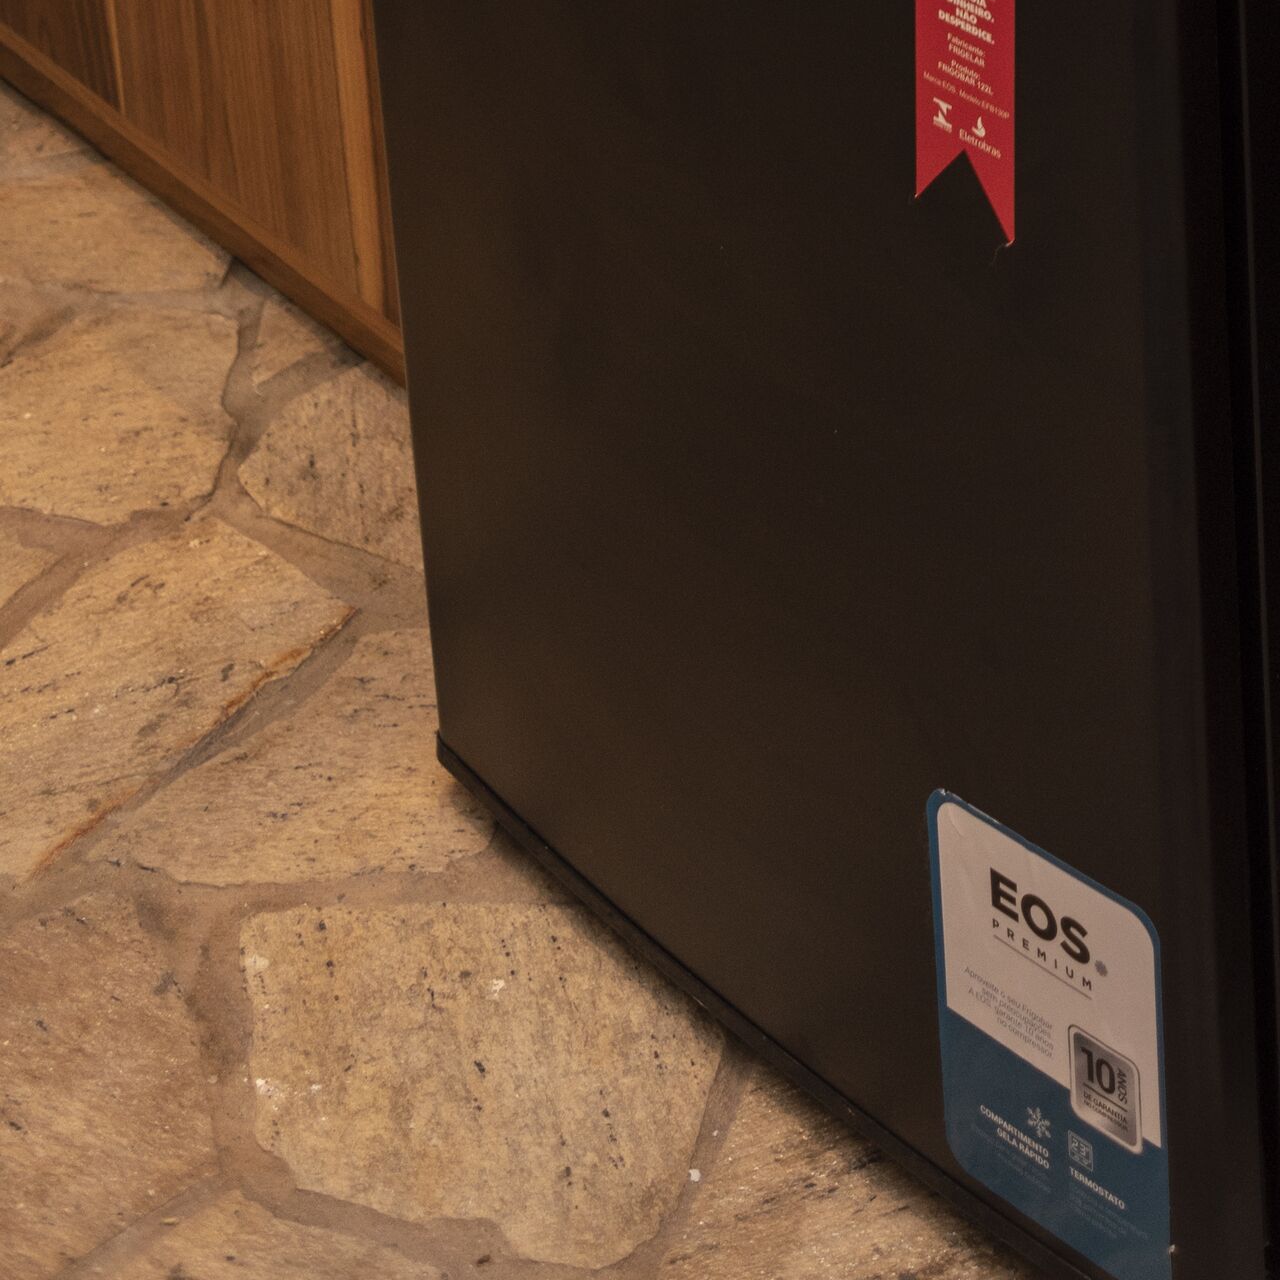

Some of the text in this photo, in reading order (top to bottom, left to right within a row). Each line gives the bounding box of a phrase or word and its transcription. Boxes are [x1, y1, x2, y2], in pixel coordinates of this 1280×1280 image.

[938, 9, 995, 45] DESPERDICE.
[955, 6, 978, 25] NÃO
[959, 128, 1001, 159] Eletrobras
[989, 866, 1092, 966] EOS
[992, 917, 1094, 991] PREMIUM
[1080, 1046, 1115, 1094] 10
[1117, 1068, 1128, 1105] ANOS
[980, 1104, 1049, 1158] COMPARTIMENTO
[996, 1127, 1050, 1169] GELA RÁPIDO
[1069, 1166, 1125, 1210] TERMOSTATO
